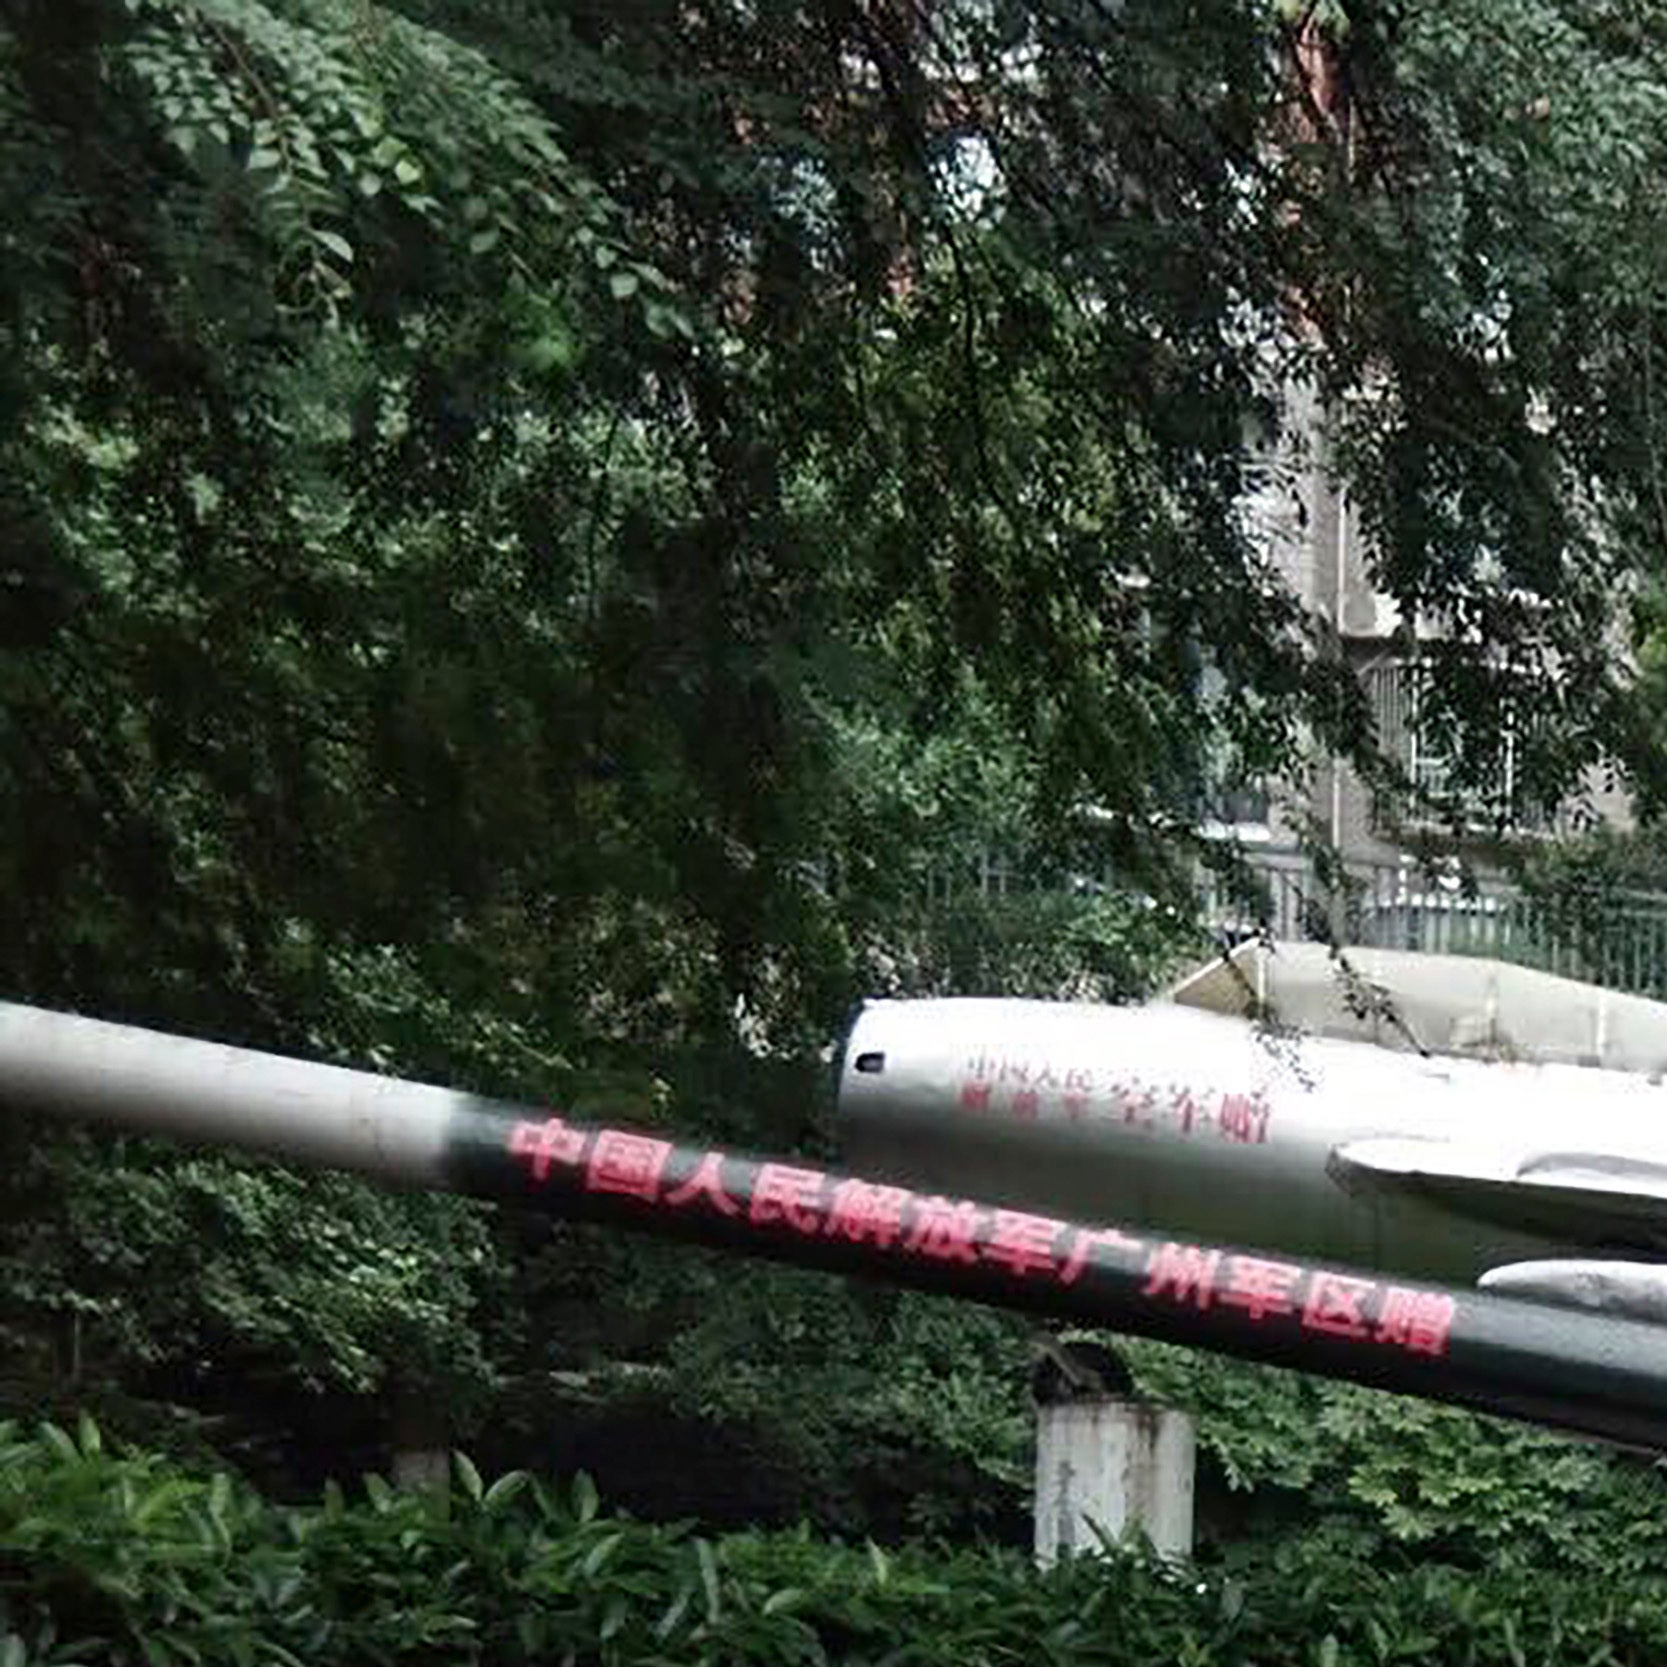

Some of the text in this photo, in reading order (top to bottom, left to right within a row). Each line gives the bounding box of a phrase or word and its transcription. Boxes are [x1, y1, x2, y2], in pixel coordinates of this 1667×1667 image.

[508, 1117, 1453, 1357] 中国人民解放军广州军区赠
